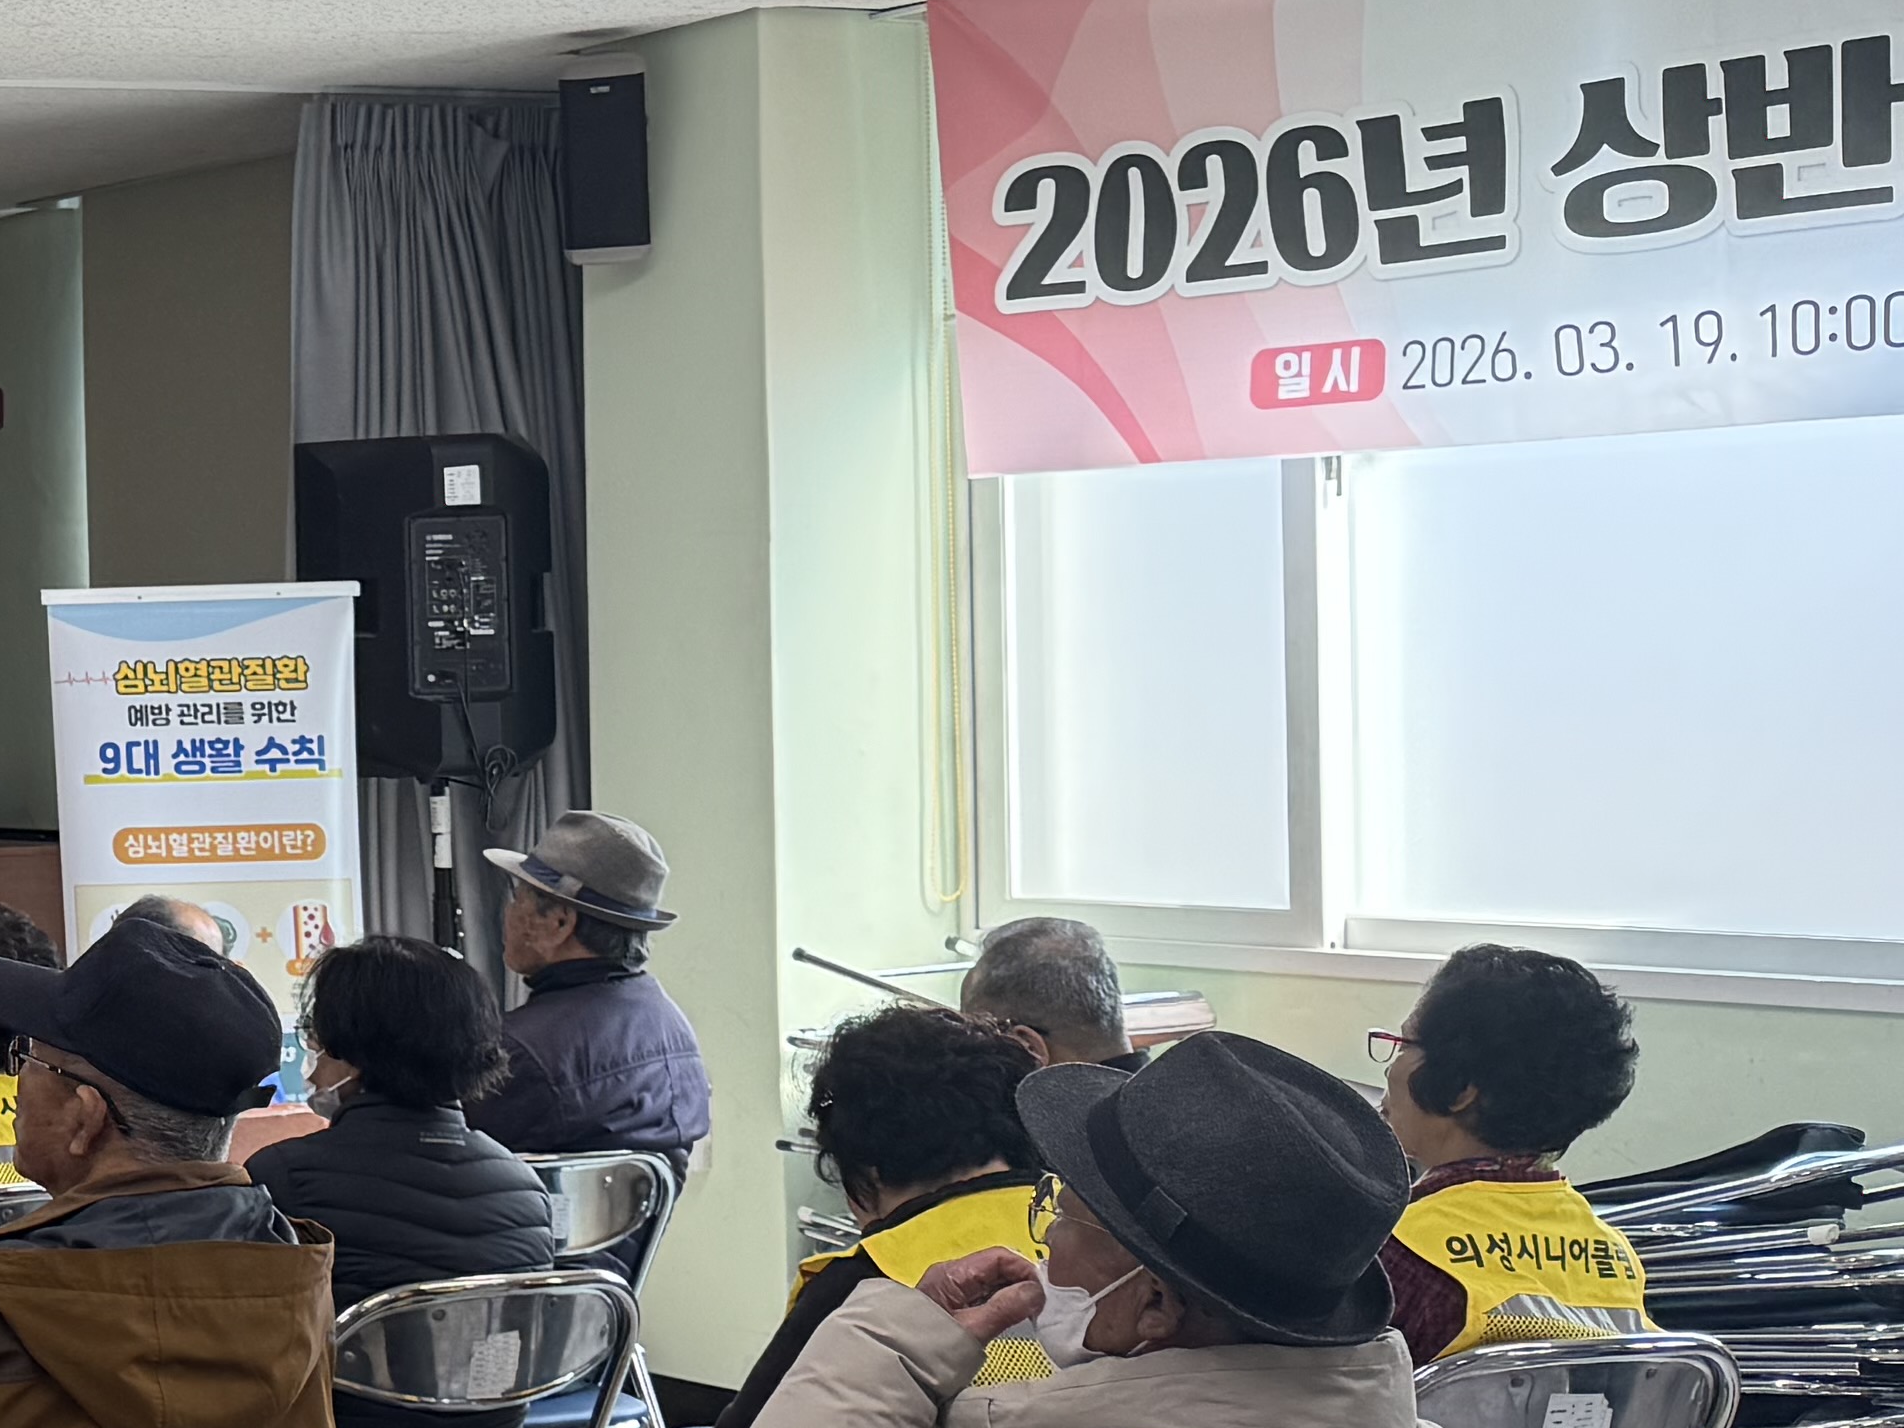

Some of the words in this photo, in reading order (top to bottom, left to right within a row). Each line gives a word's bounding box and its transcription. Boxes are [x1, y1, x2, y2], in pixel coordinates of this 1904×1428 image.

[1002, 96, 1508, 303] 2026년
[1550, 34, 1904, 238] 상반
[1400, 329, 1534, 391] 2026.
[1553, 322, 1635, 375] 03.
[1658, 309, 1738, 368] 19.
[1759, 290, 1904, 359] 10:00
[113, 655, 309, 695] 심뇌혈관질환
[127, 702, 172, 727] 예방
[177, 701, 246, 727] 관리를
[250, 700, 297, 724] 위한
[98, 738, 161, 776] 9대
[171, 736, 245, 775] 생활
[254, 734, 327, 772] 수칙
[123, 829, 316, 859] 심뇌혈관질환이란?
